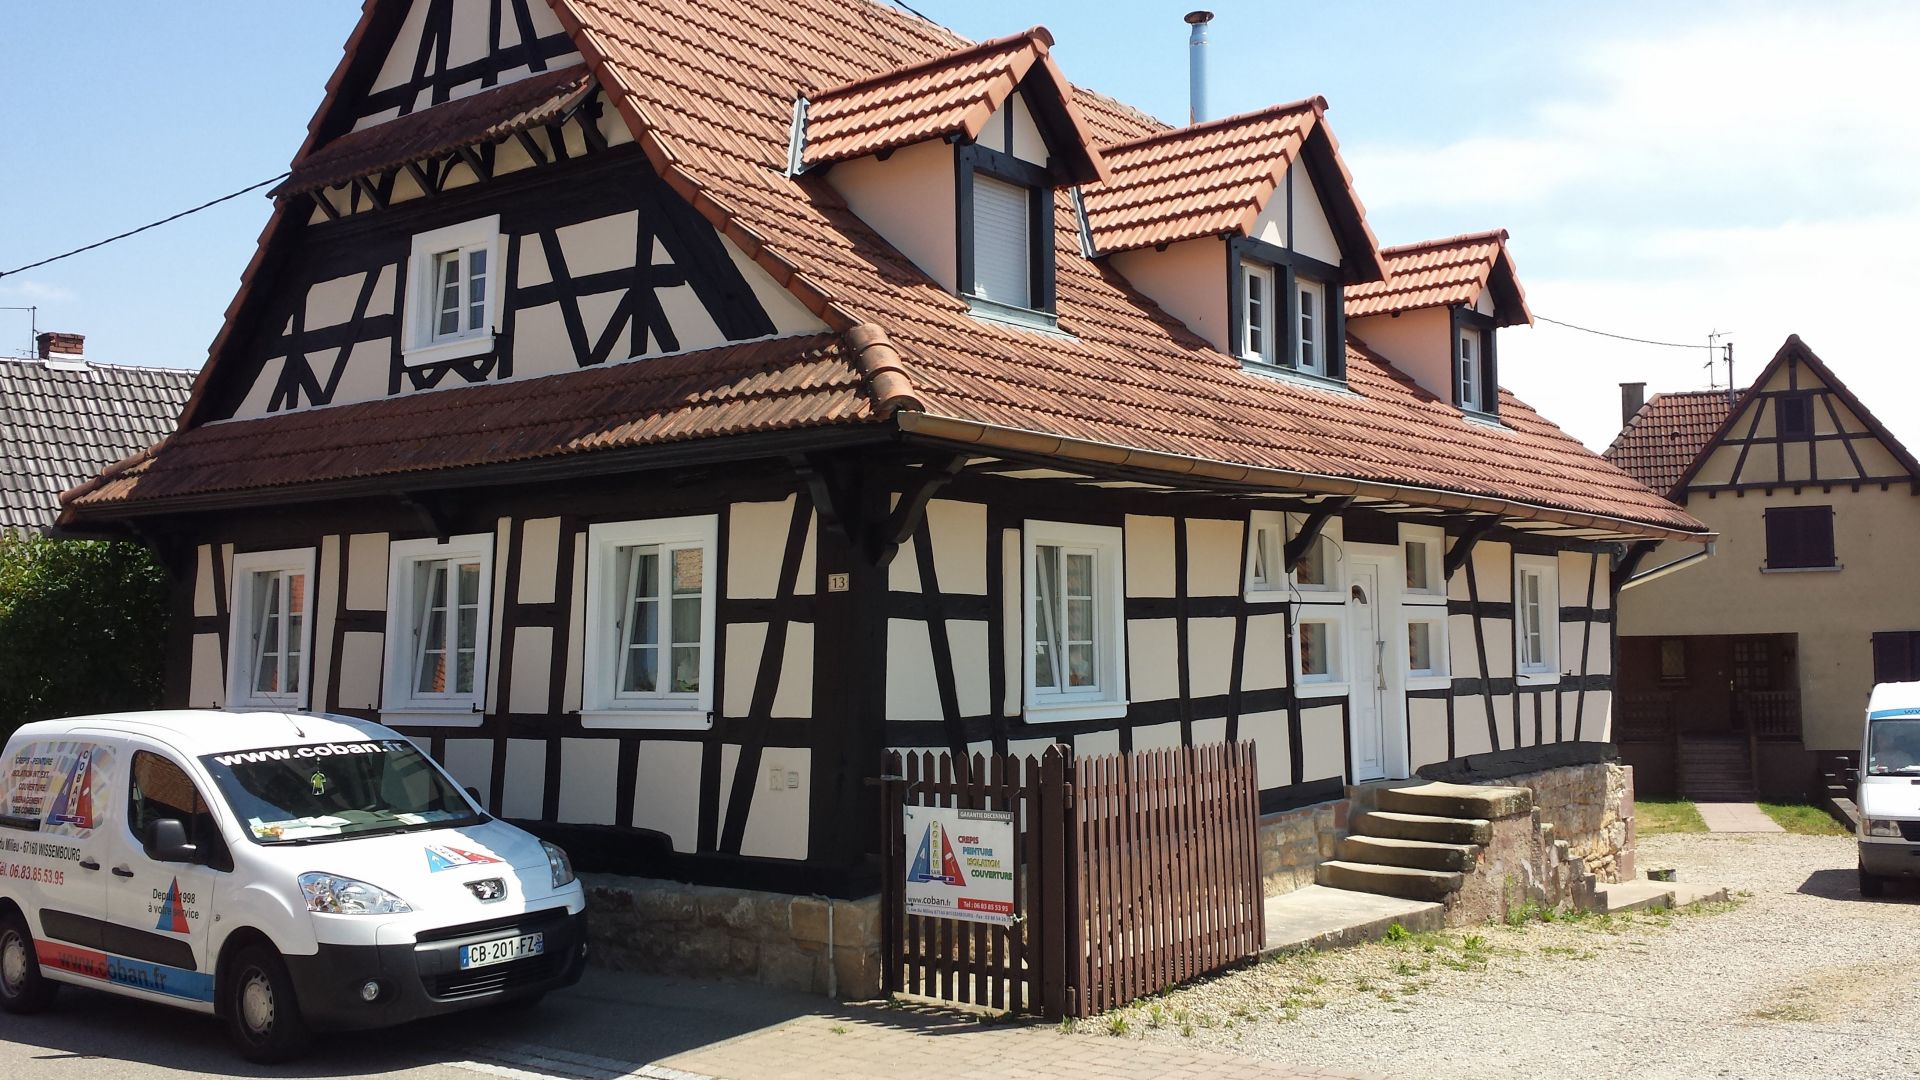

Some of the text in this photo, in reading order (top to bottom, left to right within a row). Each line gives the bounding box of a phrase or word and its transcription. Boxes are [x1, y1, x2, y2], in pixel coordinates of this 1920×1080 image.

[832, 576, 845, 589] 13
[214, 740, 403, 766] www.coban.fr
[70, 750, 89, 807] COBAN
[960, 811, 984, 819] GARANTIE
[958, 836, 979, 844] CREPIS
[23, 841, 38, 855] 67160
[39, 843, 80, 861] WISSEMBOURG
[963, 847, 993, 856] PEINTURE
[967, 857, 1000, 868] ISOLATION
[9, 864, 64, 885] 06.83.85.53.95
[971, 869, 1012, 880] COUVERTURE
[153, 889, 196, 904] Depuis 1998
[908, 896, 951, 907] www.coban.fr
[59, 952, 166, 990] www.coban.fr
